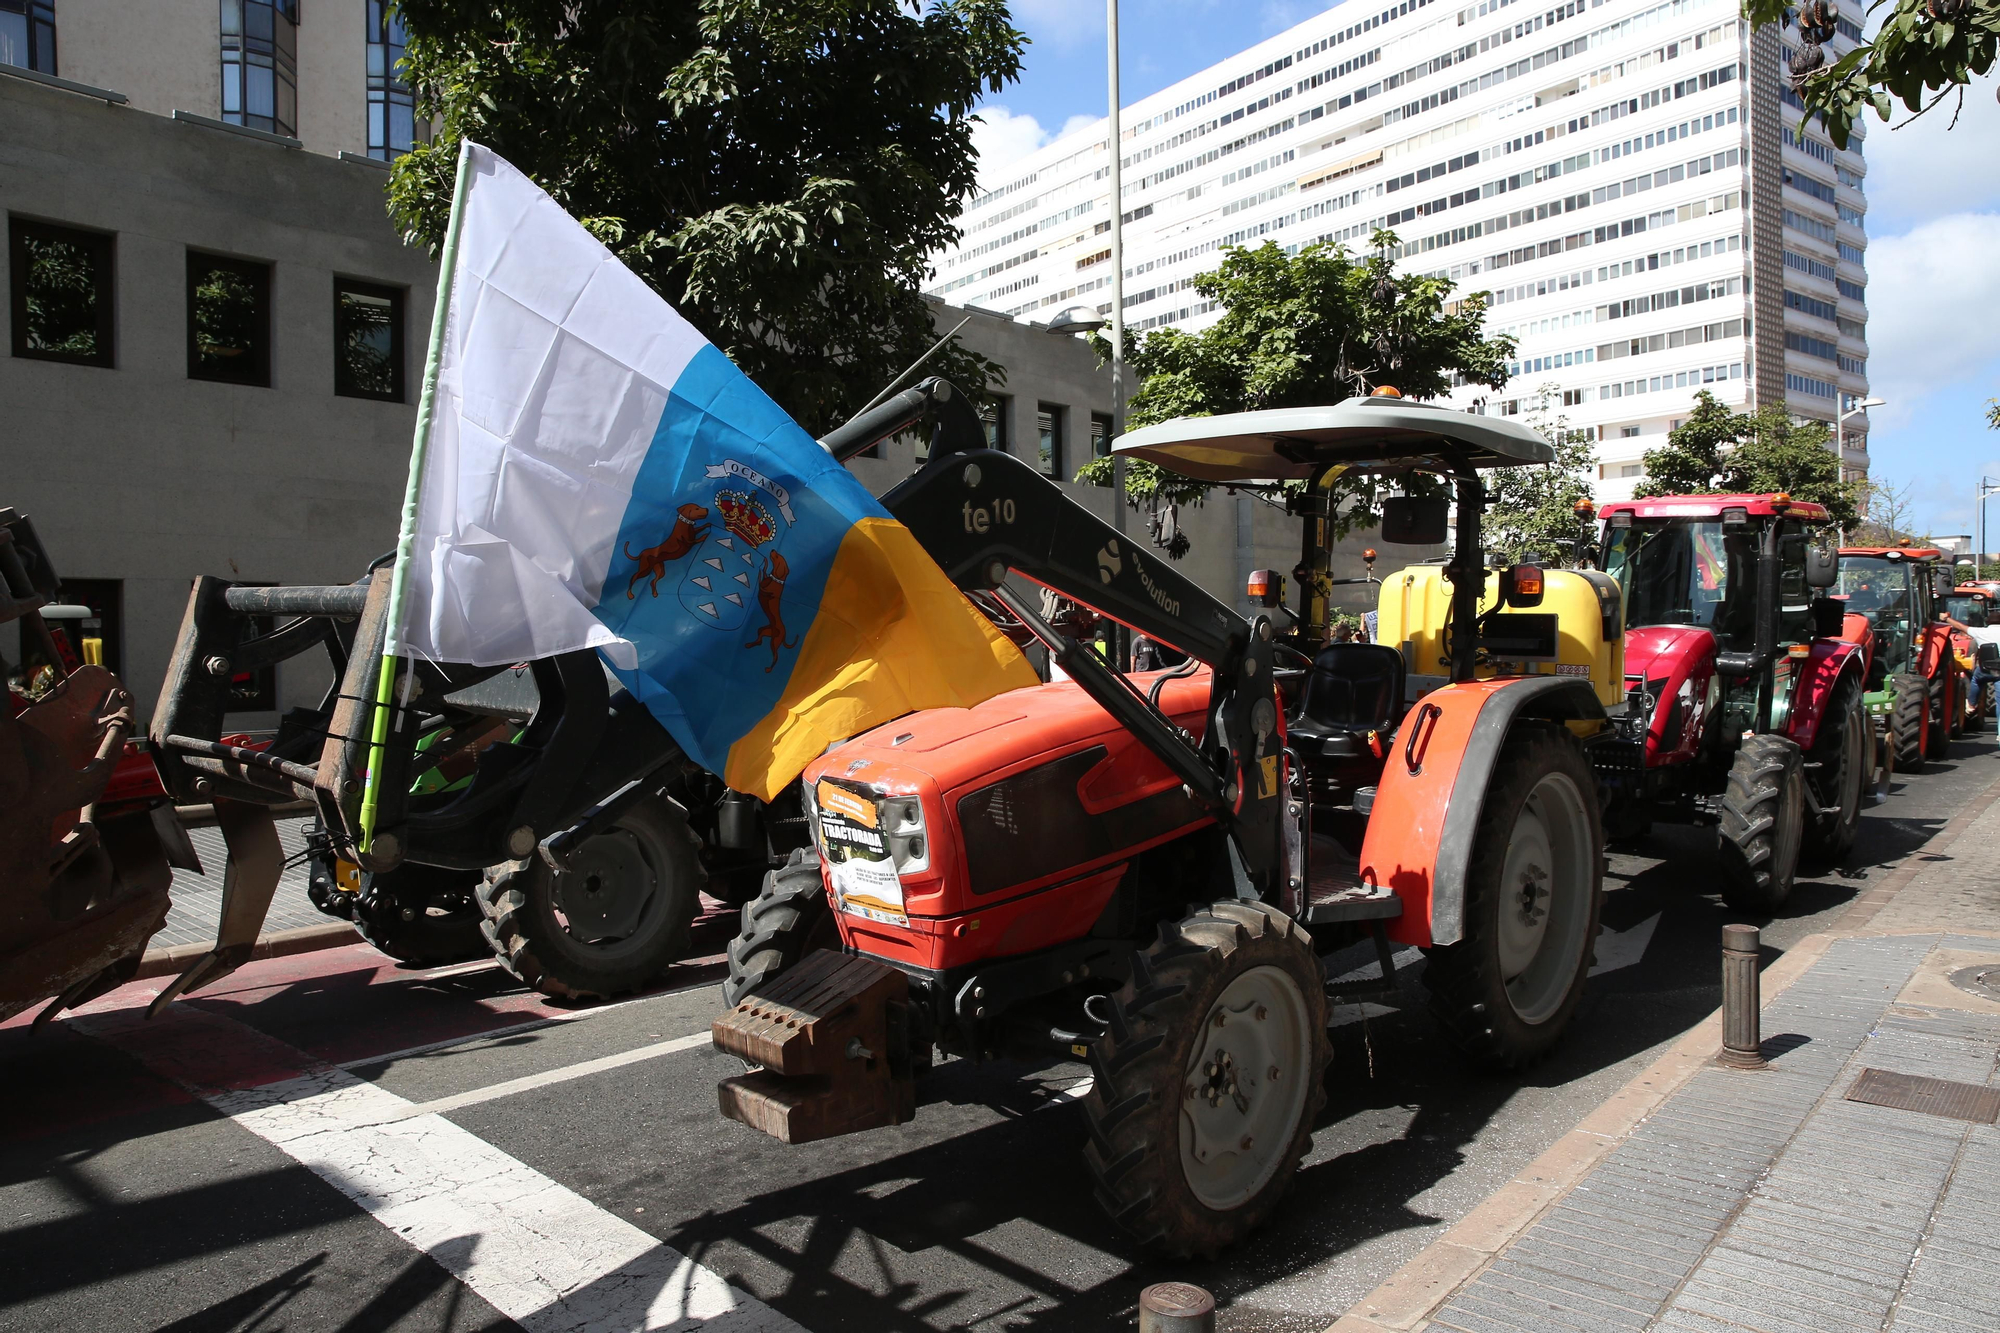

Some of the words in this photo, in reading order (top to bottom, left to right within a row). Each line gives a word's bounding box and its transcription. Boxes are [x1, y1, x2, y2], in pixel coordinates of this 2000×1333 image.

[731, 463, 784, 498] OCEANO
[1131, 552, 1181, 617] evolution
[822, 823, 883, 848] TRACTORADA
